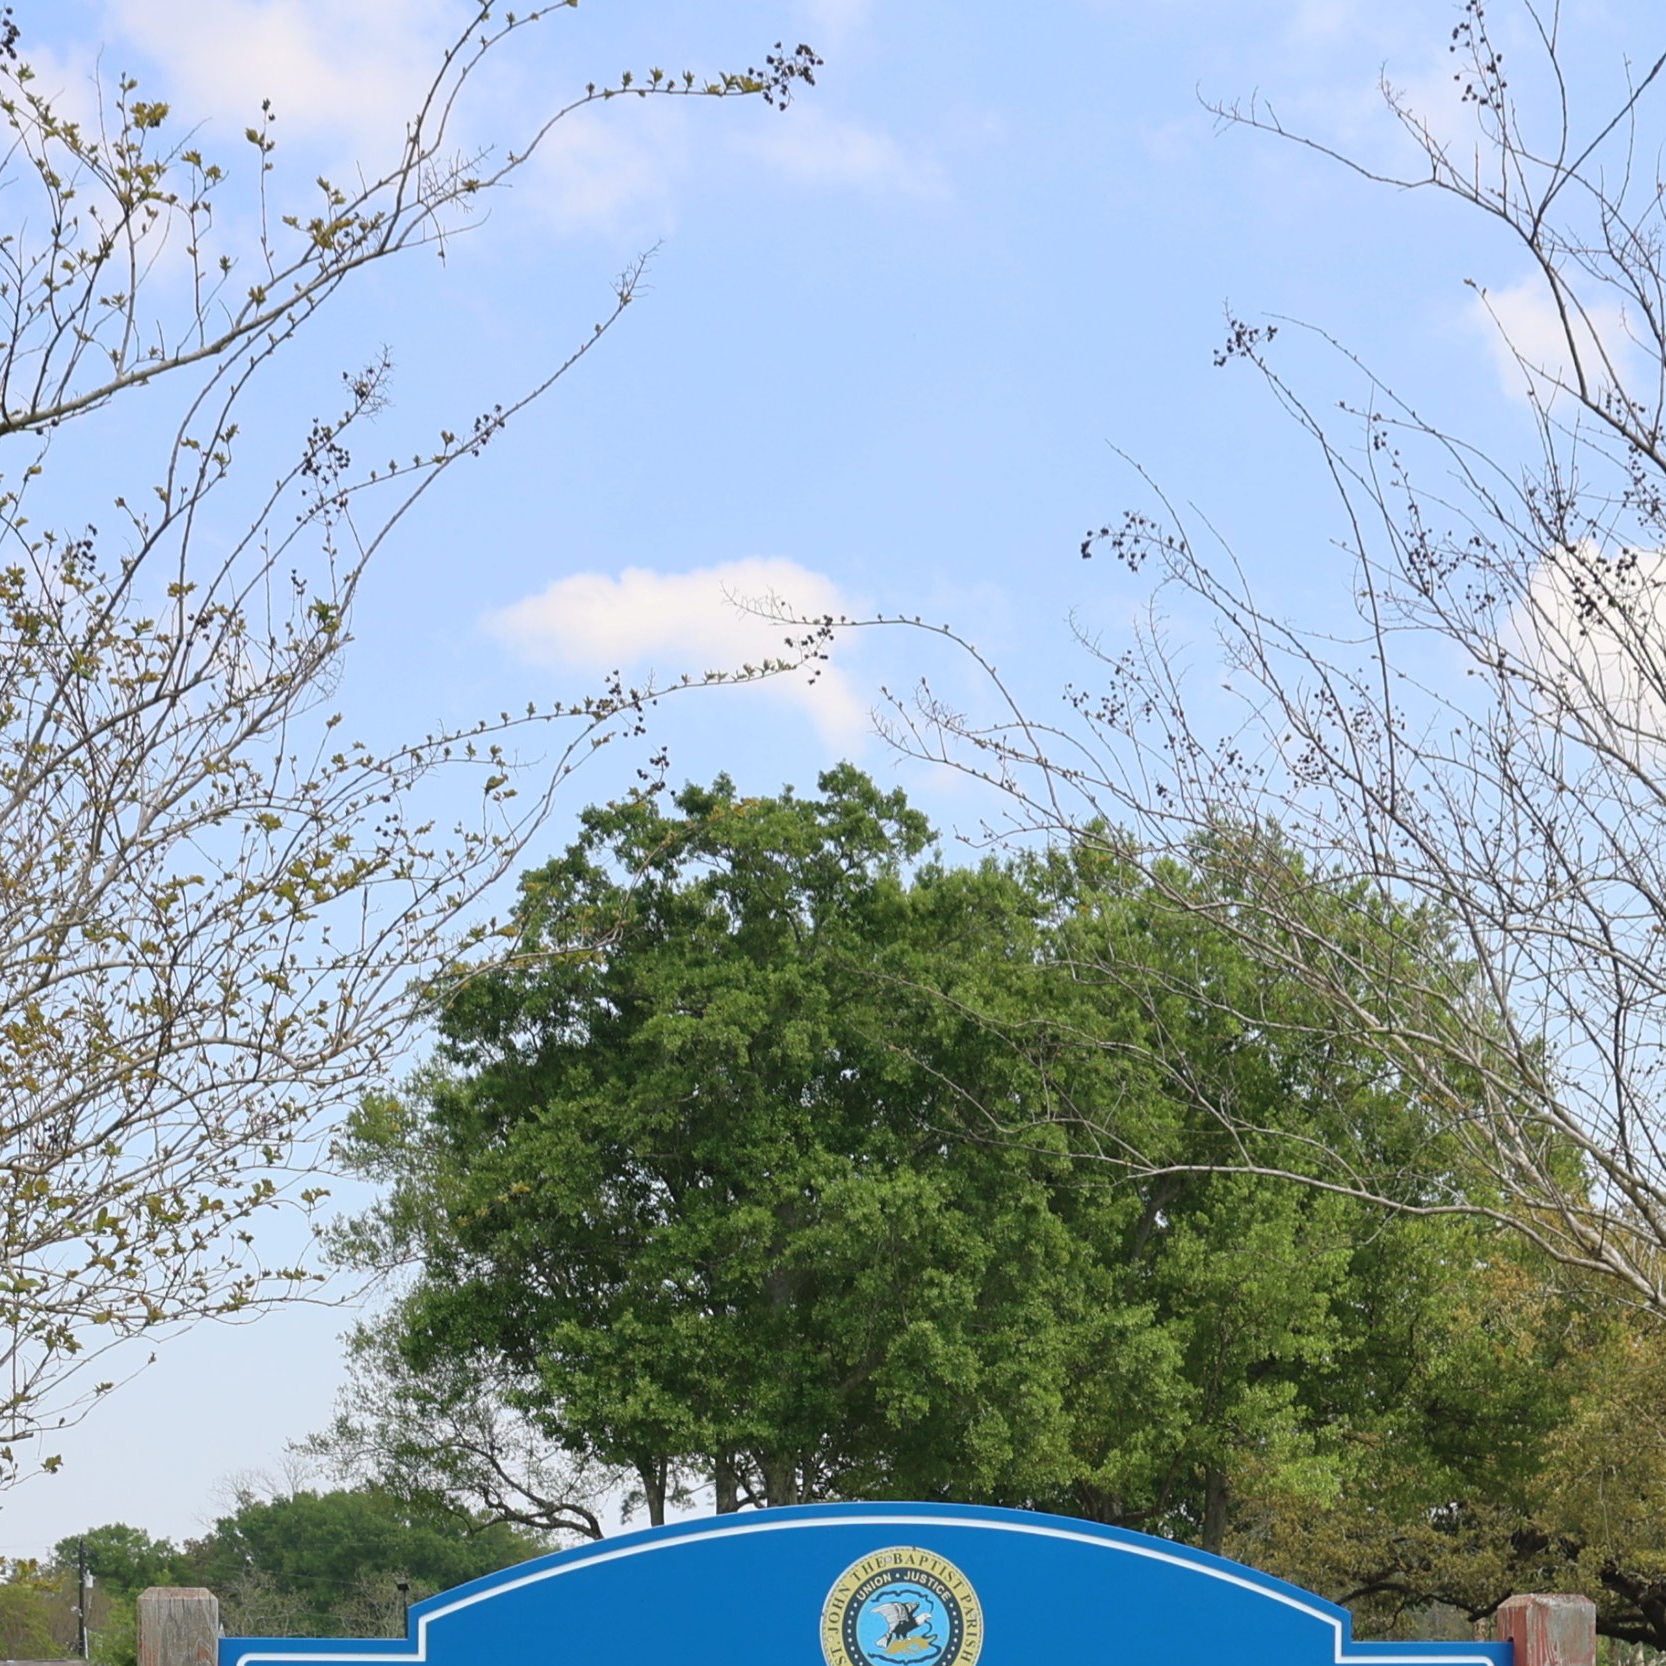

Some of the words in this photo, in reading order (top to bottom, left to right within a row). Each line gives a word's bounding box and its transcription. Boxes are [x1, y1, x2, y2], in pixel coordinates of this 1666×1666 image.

[849, 1556, 887, 1583] THE
[856, 1572, 892, 1601] UNION
[903, 1570, 952, 1602] JUSTICE
[892, 1552, 965, 1590] BAPTIST
[827, 1586, 852, 1634] JOHN
[960, 1593, 978, 1663] PARISH
[829, 1640, 847, 1666] ST.
